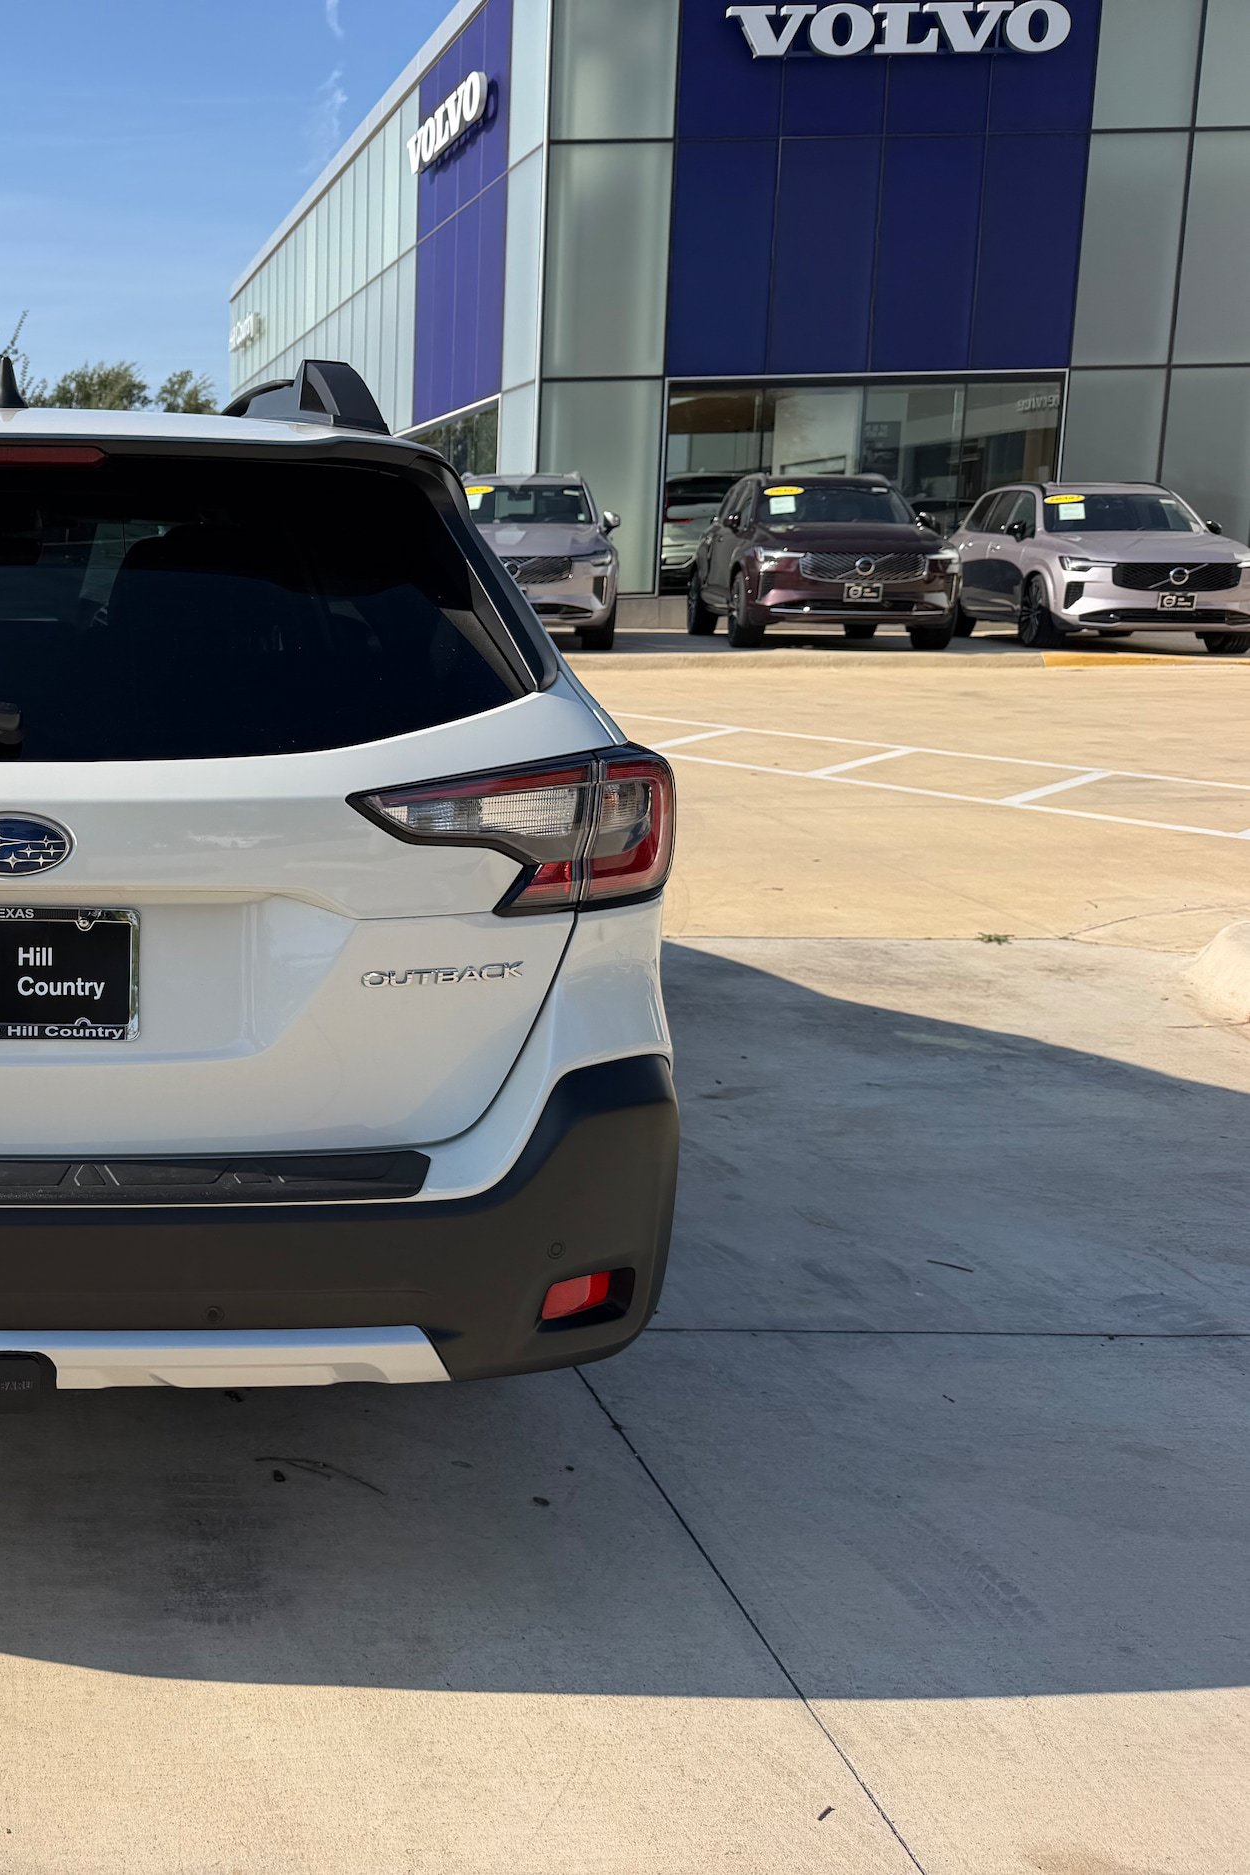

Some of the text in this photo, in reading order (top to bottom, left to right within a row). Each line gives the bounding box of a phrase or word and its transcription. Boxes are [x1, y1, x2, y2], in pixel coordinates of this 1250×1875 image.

[725, 0, 1072, 58] VOLVO
[406, 70, 487, 175] VOLVO
[18, 946, 53, 967] Hill
[361, 960, 524, 988] OUTBACK
[17, 976, 105, 1000] Country
[7, 1025, 39, 1037] Hill
[45, 1026, 124, 1039] Country
